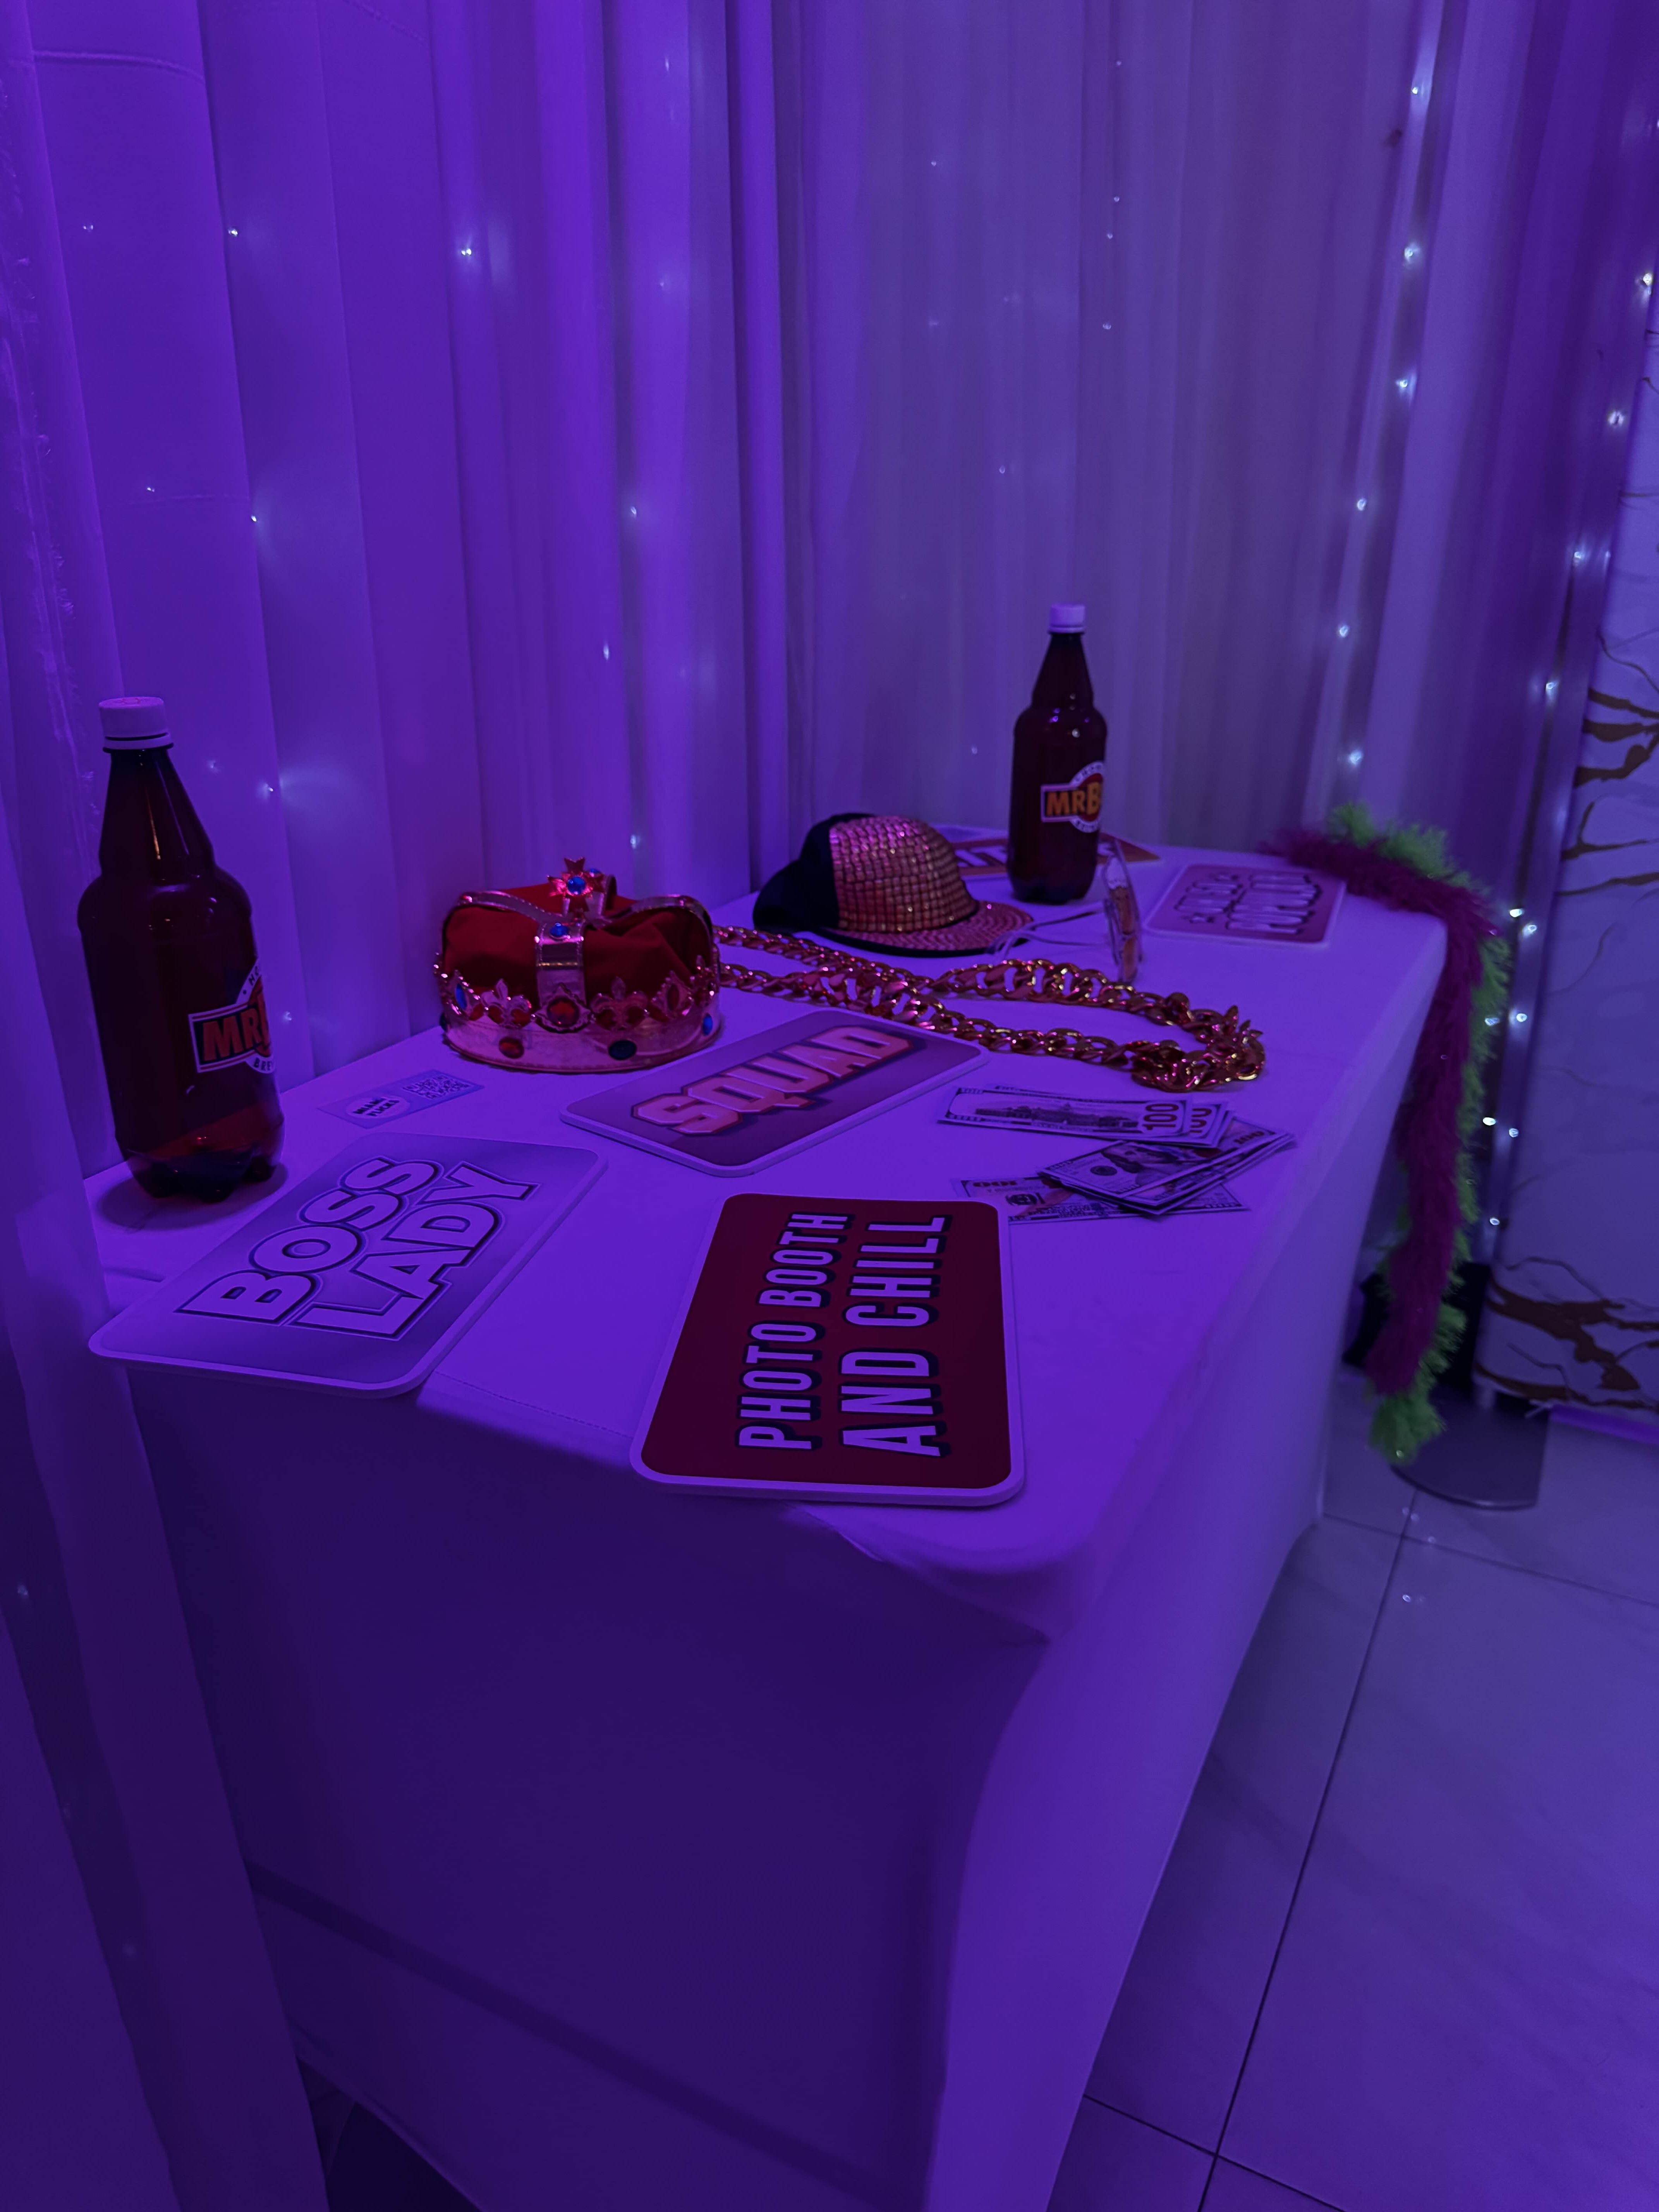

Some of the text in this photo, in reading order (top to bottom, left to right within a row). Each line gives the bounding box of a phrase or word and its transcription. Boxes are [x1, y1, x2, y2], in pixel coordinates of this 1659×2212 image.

[632, 1025, 915, 1135] SQUAD
[1142, 1103, 1179, 1131] 100
[173, 1157, 443, 1324] BOSS
[288, 1163, 538, 1338] LADY
[737, 1212, 853, 1450] PHOTO BOOTH
[840, 1214, 951, 1458] AND CHILL
